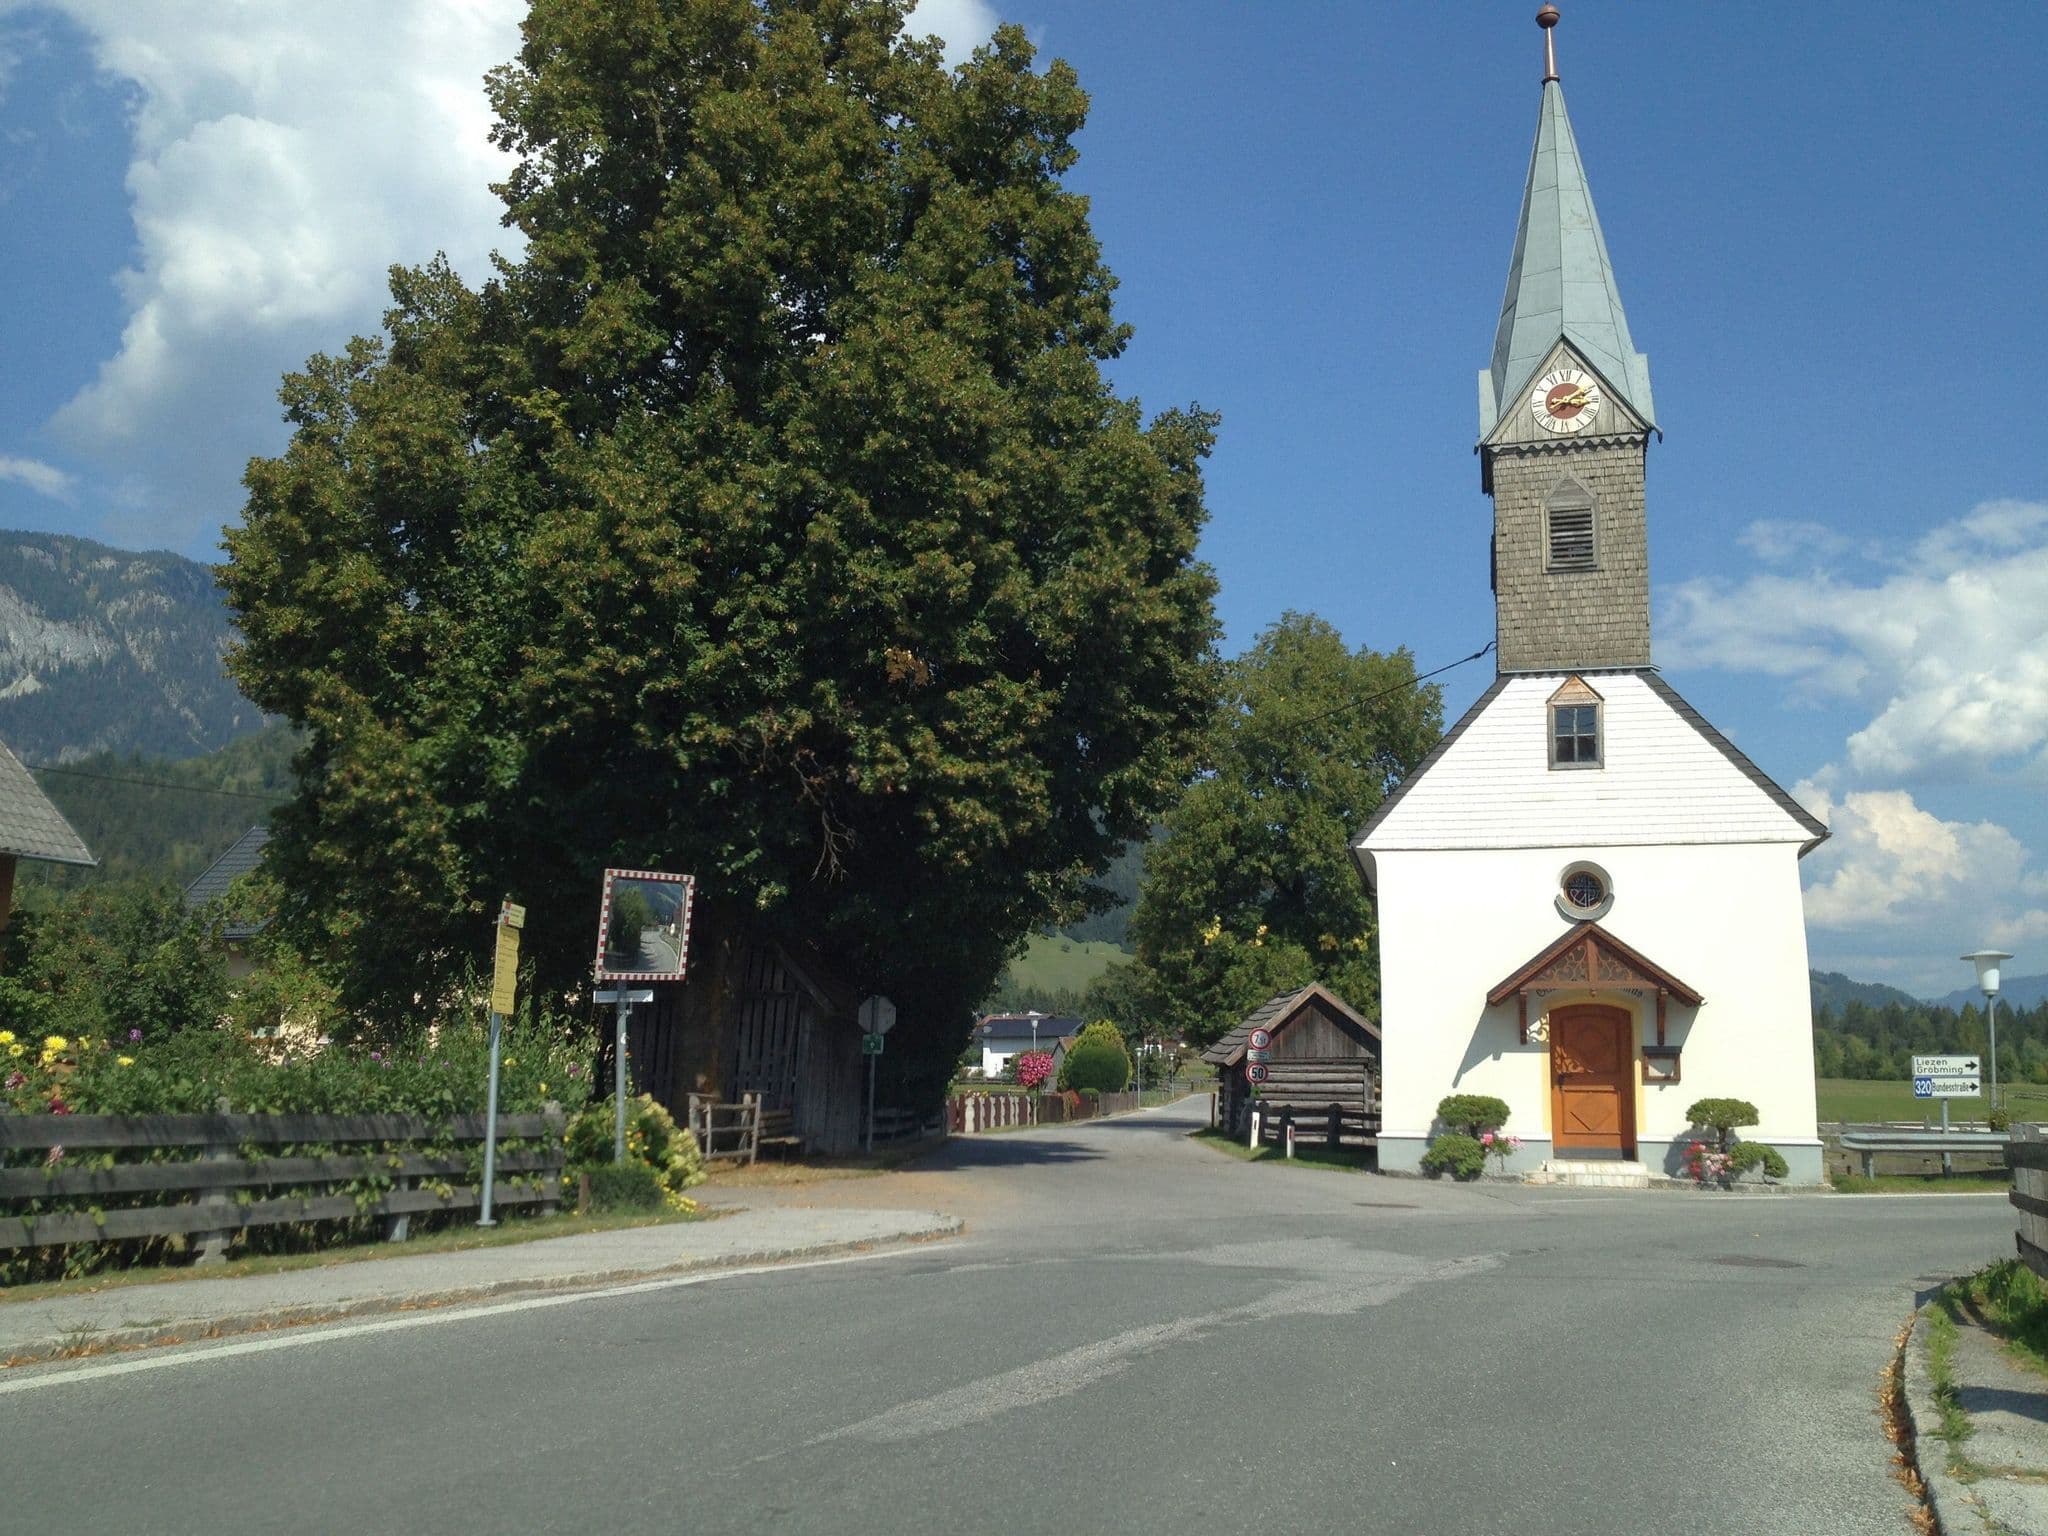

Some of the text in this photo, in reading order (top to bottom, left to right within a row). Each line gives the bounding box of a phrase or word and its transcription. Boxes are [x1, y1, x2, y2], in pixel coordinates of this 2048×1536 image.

[1916, 1058, 1948, 1066] Liezen
[1251, 1067, 1264, 1079] 50
[1915, 1080, 1932, 1095] 320
